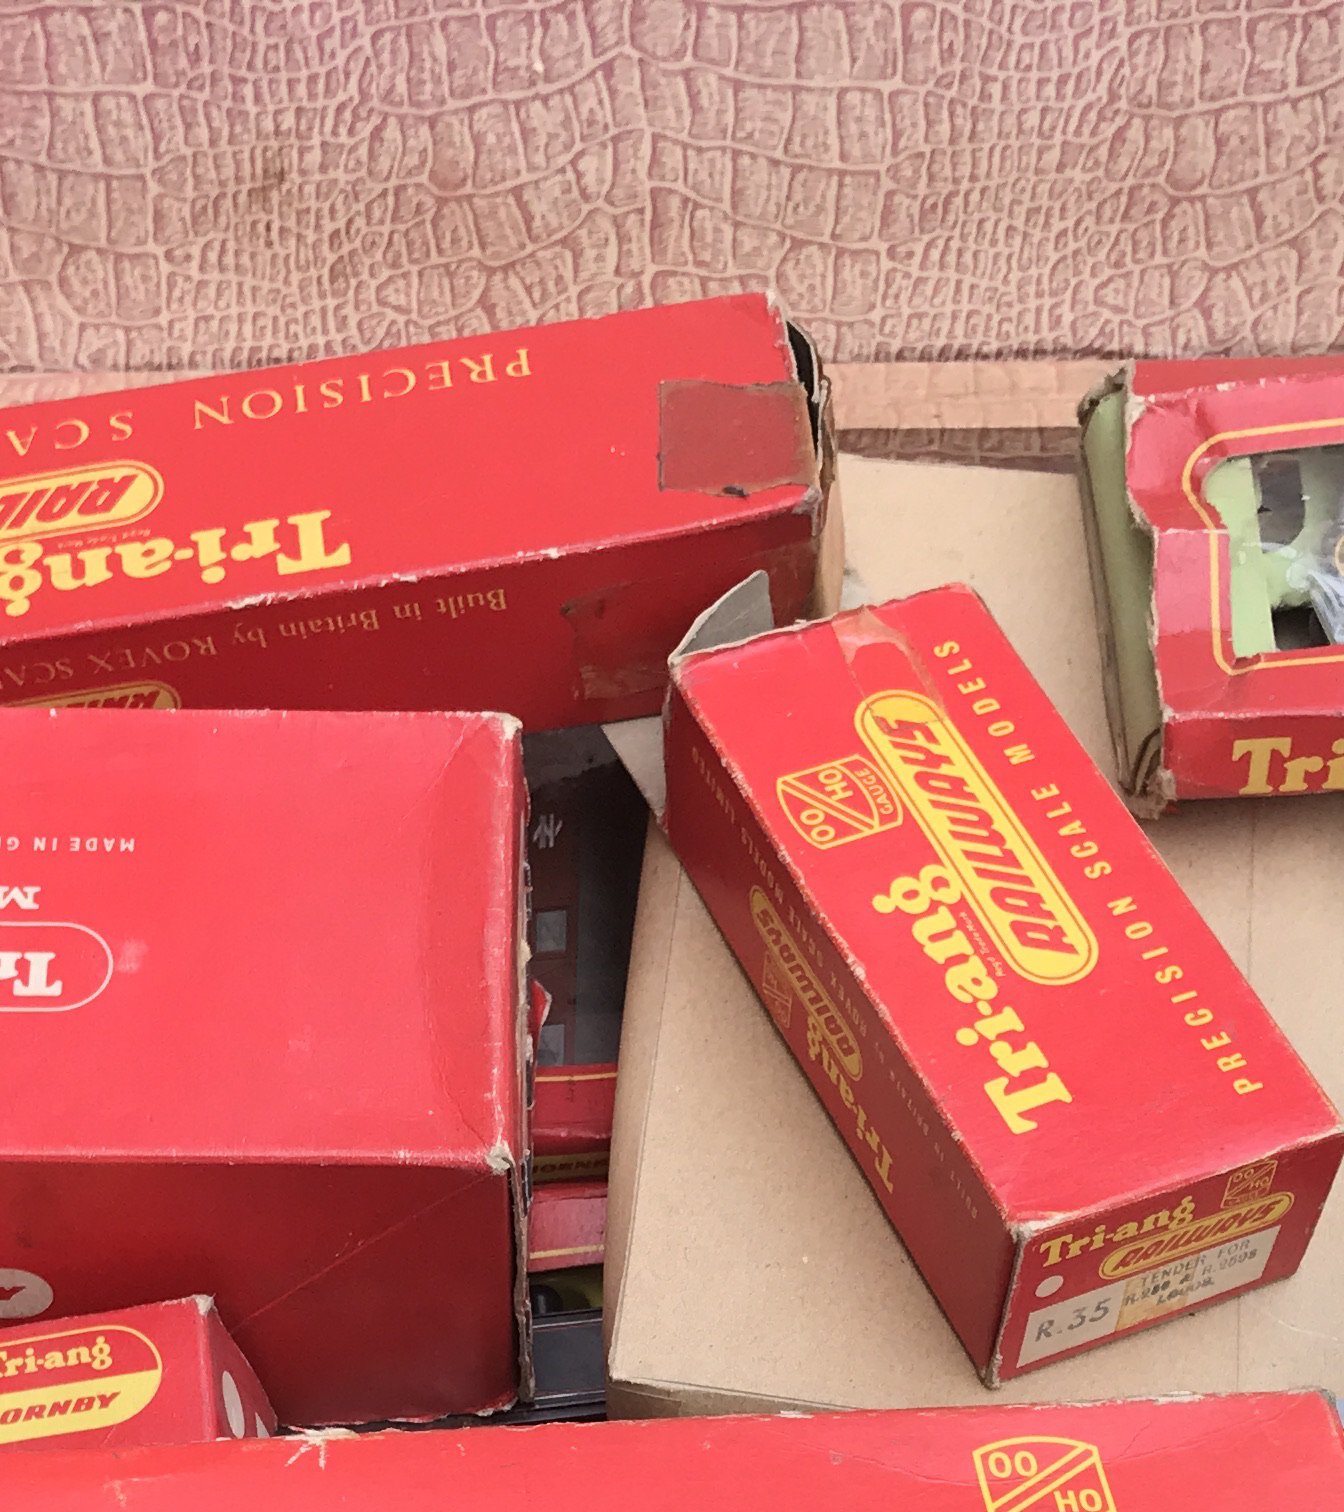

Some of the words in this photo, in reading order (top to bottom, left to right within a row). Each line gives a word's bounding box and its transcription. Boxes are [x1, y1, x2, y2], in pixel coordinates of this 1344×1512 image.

[194, 349, 532, 430] PRECISION
[280, 609, 379, 639] Britain
[393, 602, 421, 619] in
[437, 588, 506, 617] Built
[88, 635, 216, 674] ROVEX
[233, 622, 267, 649] by
[933, 640, 1035, 765] MODELS
[817, 768, 853, 802] HO
[855, 768, 895, 815] GAUGE
[34, 836, 57, 852] IN
[70, 836, 134, 852] MADE
[799, 808, 836, 844] OO
[873, 716, 1080, 955] RAILWAYS
[1030, 784, 1113, 880] SCALE
[756, 908, 856, 1057] RAILWAYS
[872, 864, 1072, 1135] Tri-ang
[1107, 897, 1263, 1095] PRECISION
[807, 1016, 894, 1194] Tri-ang
[1040, 1196, 1195, 1267] Tri-ang
[1112, 1200, 1283, 1271] RAILWAYS
[1141, 1254, 1205, 1286] TENDER
[1217, 1239, 1250, 1258] FOR
[1035, 1297, 1111, 1342] R.35
[988, 1451, 1037, 1478] OO
[1053, 1488, 1102, 1512] HO
